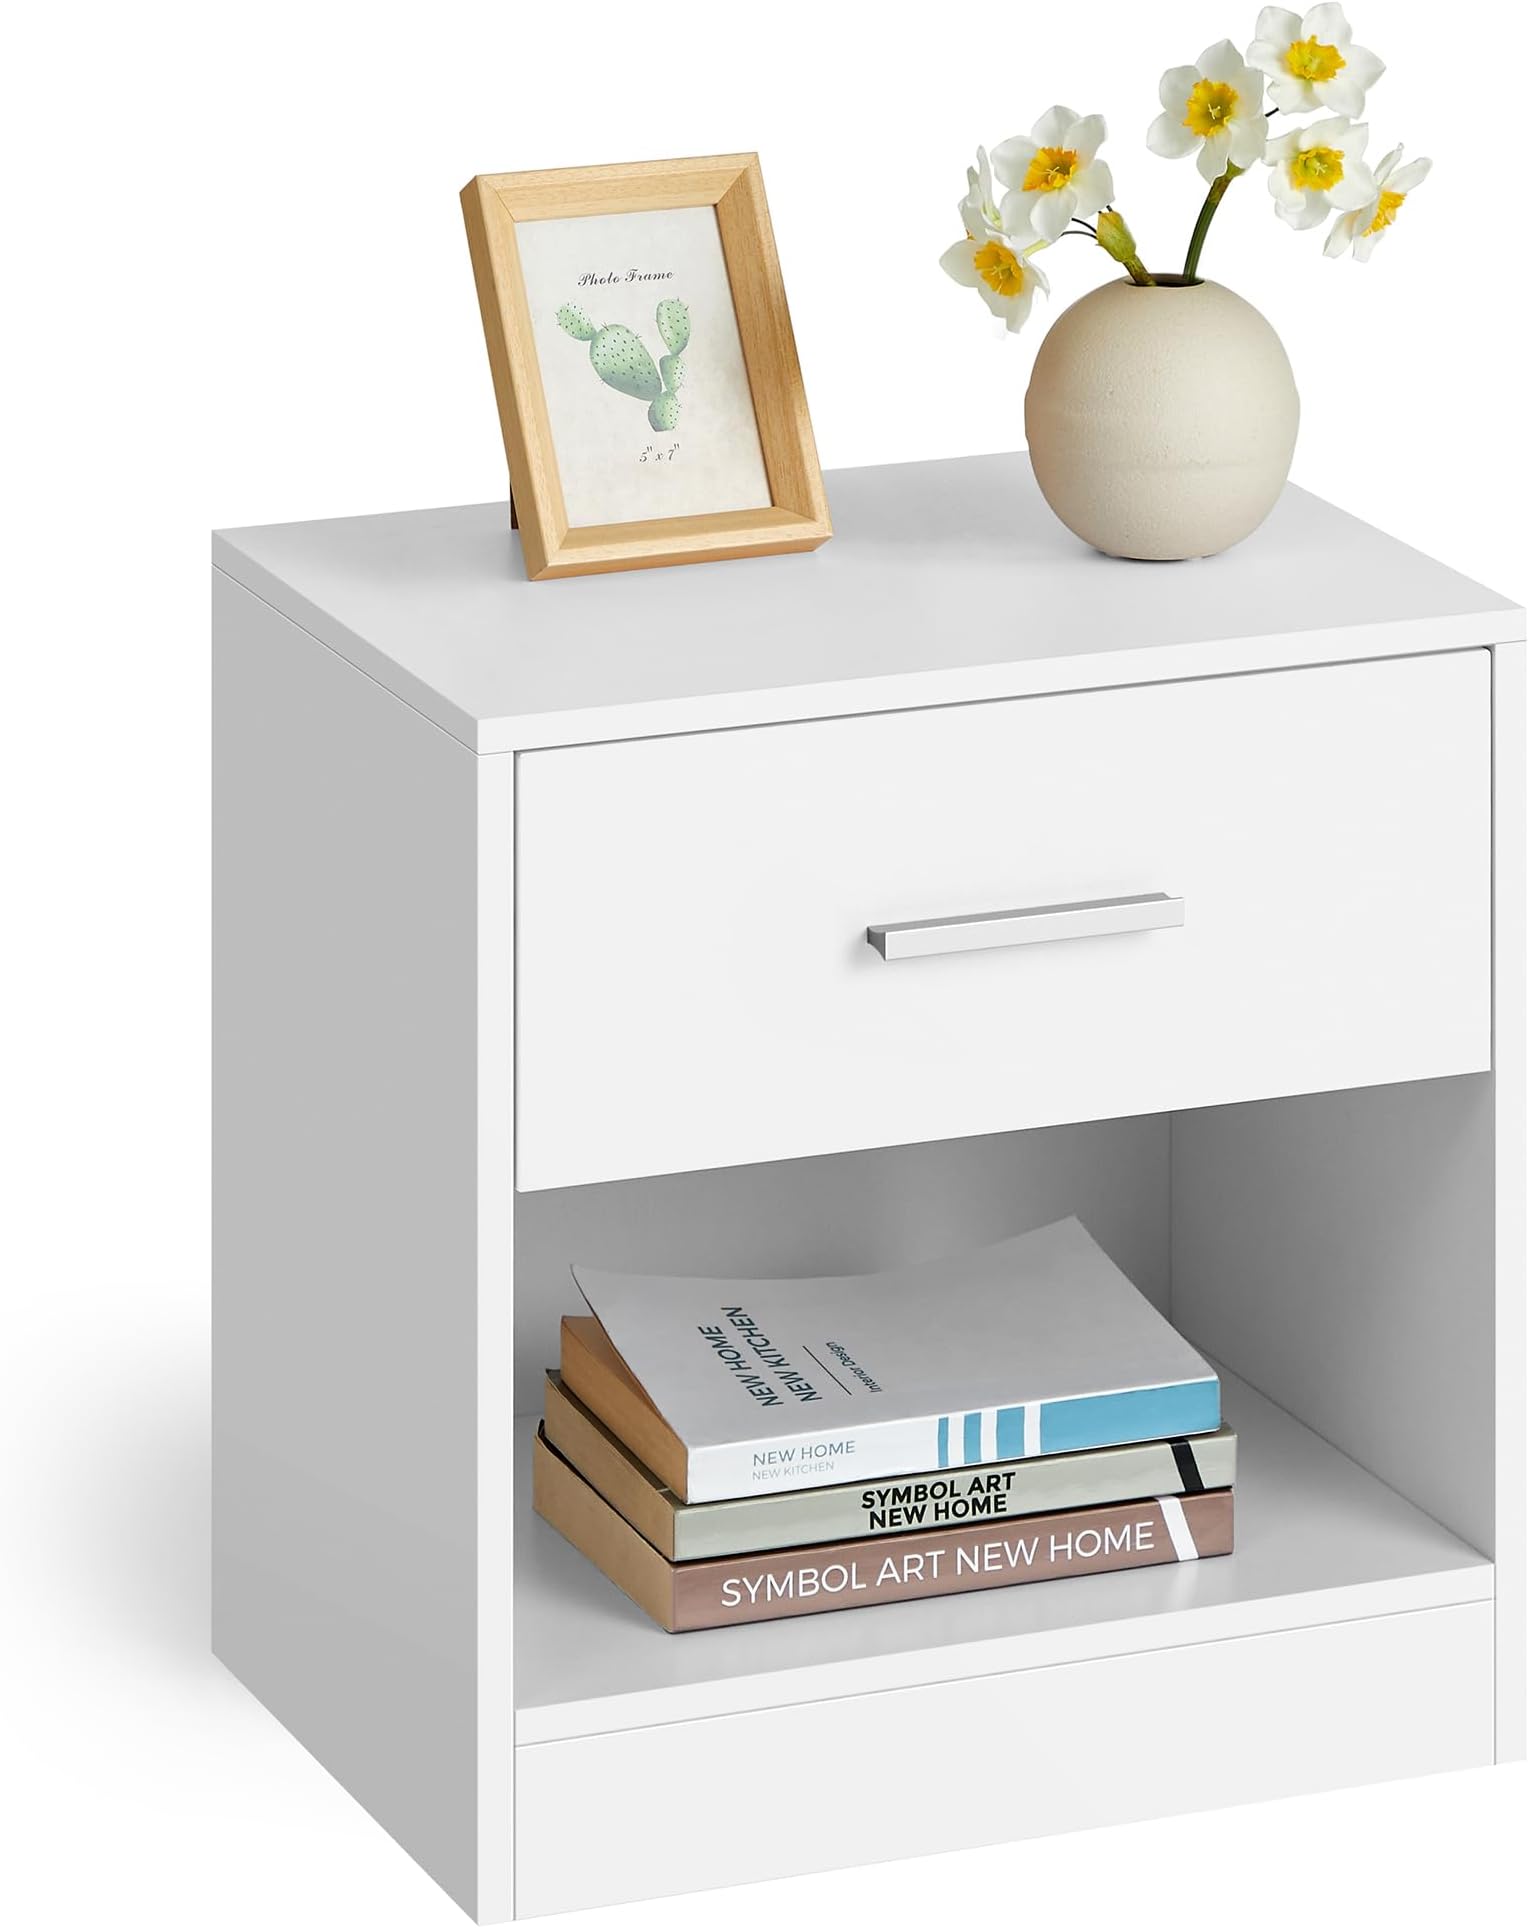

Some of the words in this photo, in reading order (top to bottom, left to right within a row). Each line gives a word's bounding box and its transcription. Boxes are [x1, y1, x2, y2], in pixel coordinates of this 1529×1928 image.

[624, 268, 674, 283] Frame
[697, 1326, 752, 1371] HOME
[720, 1306, 790, 1368] KITCHEN
[826, 1341, 856, 1367] Design
[735, 1374, 784, 1407] NEW
[774, 1370, 822, 1402] NEW
[852, 1366, 883, 1393] Interior
[753, 1447, 796, 1467] NEW
[801, 1440, 856, 1460] HOME
[752, 1468, 781, 1481] NEW
[784, 1460, 835, 1477] KITCHEN
[861, 1480, 961, 1509] SYMBOL
[967, 1472, 1016, 1496] ART
[869, 1504, 927, 1530] NEW
[934, 1493, 1007, 1521] HOME
[720, 1560, 866, 1608] SYMBOL
[876, 1549, 946, 1587] ART
[956, 1536, 1040, 1580] NEW
[1049, 1520, 1155, 1563] HOME
